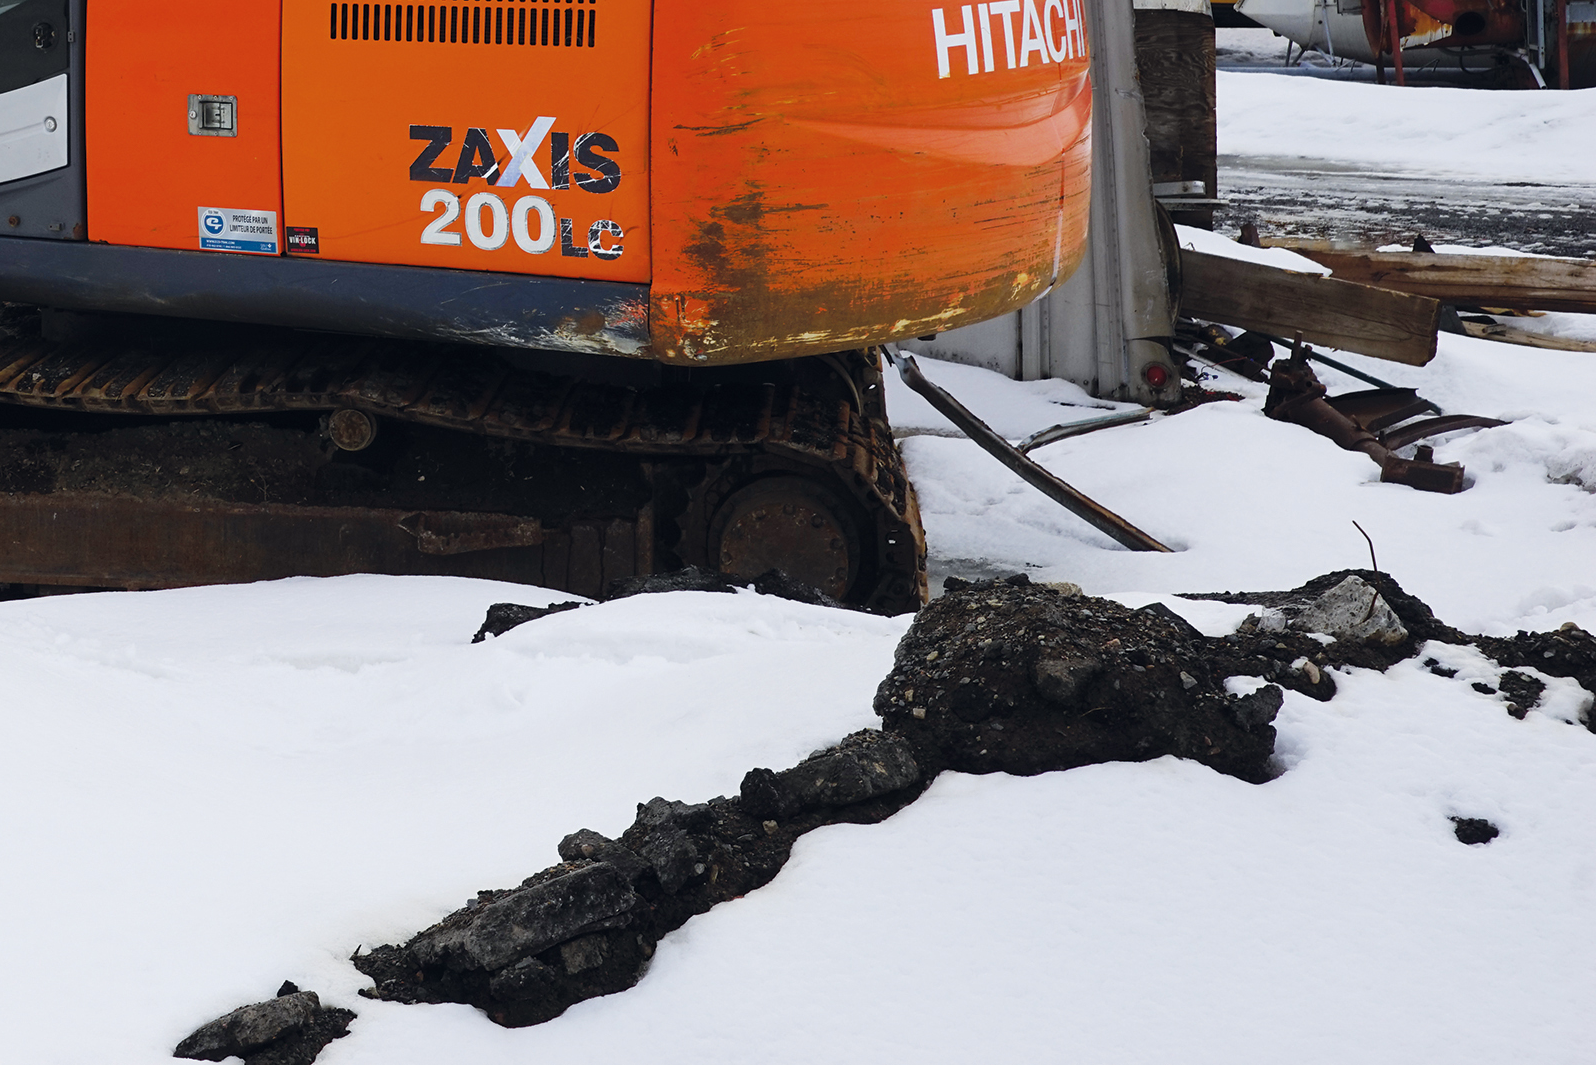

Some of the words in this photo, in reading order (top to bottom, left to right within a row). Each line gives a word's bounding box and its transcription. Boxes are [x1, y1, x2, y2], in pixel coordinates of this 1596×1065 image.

[409, 113, 622, 194] ZAXIS
[252, 216, 261, 225] PAR
[261, 217, 268, 225] UN
[229, 225, 250, 234] LIMITEUR
[249, 225, 256, 234] DE
[256, 226, 273, 235] PORTÉE
